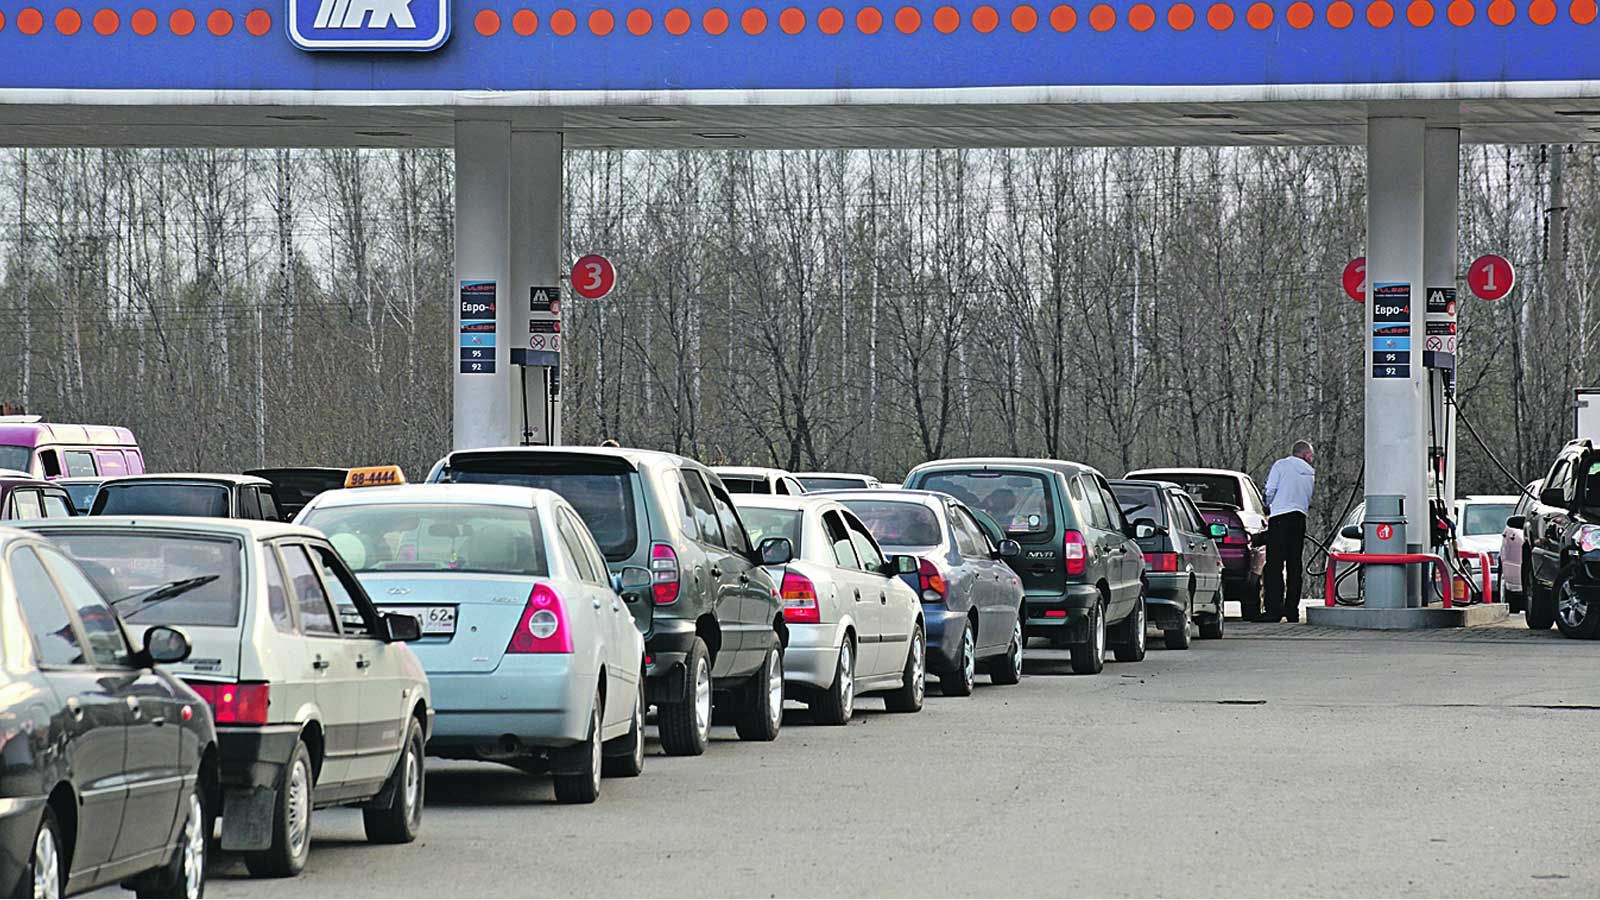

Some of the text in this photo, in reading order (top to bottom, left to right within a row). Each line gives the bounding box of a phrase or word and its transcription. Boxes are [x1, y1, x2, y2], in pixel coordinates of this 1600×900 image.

[584, 263, 602, 290] 3
[1482, 264, 1497, 290] 1
[462, 302, 496, 314] Евро-4
[1375, 304, 1409, 317] Евро-4
[472, 350, 482, 358] 95
[1386, 353, 1396, 361] 95
[472, 363, 482, 371] 92
[1386, 367, 1396, 375] 92
[351, 471, 396, 485] 98-4444
[429, 609, 448, 622] 62
